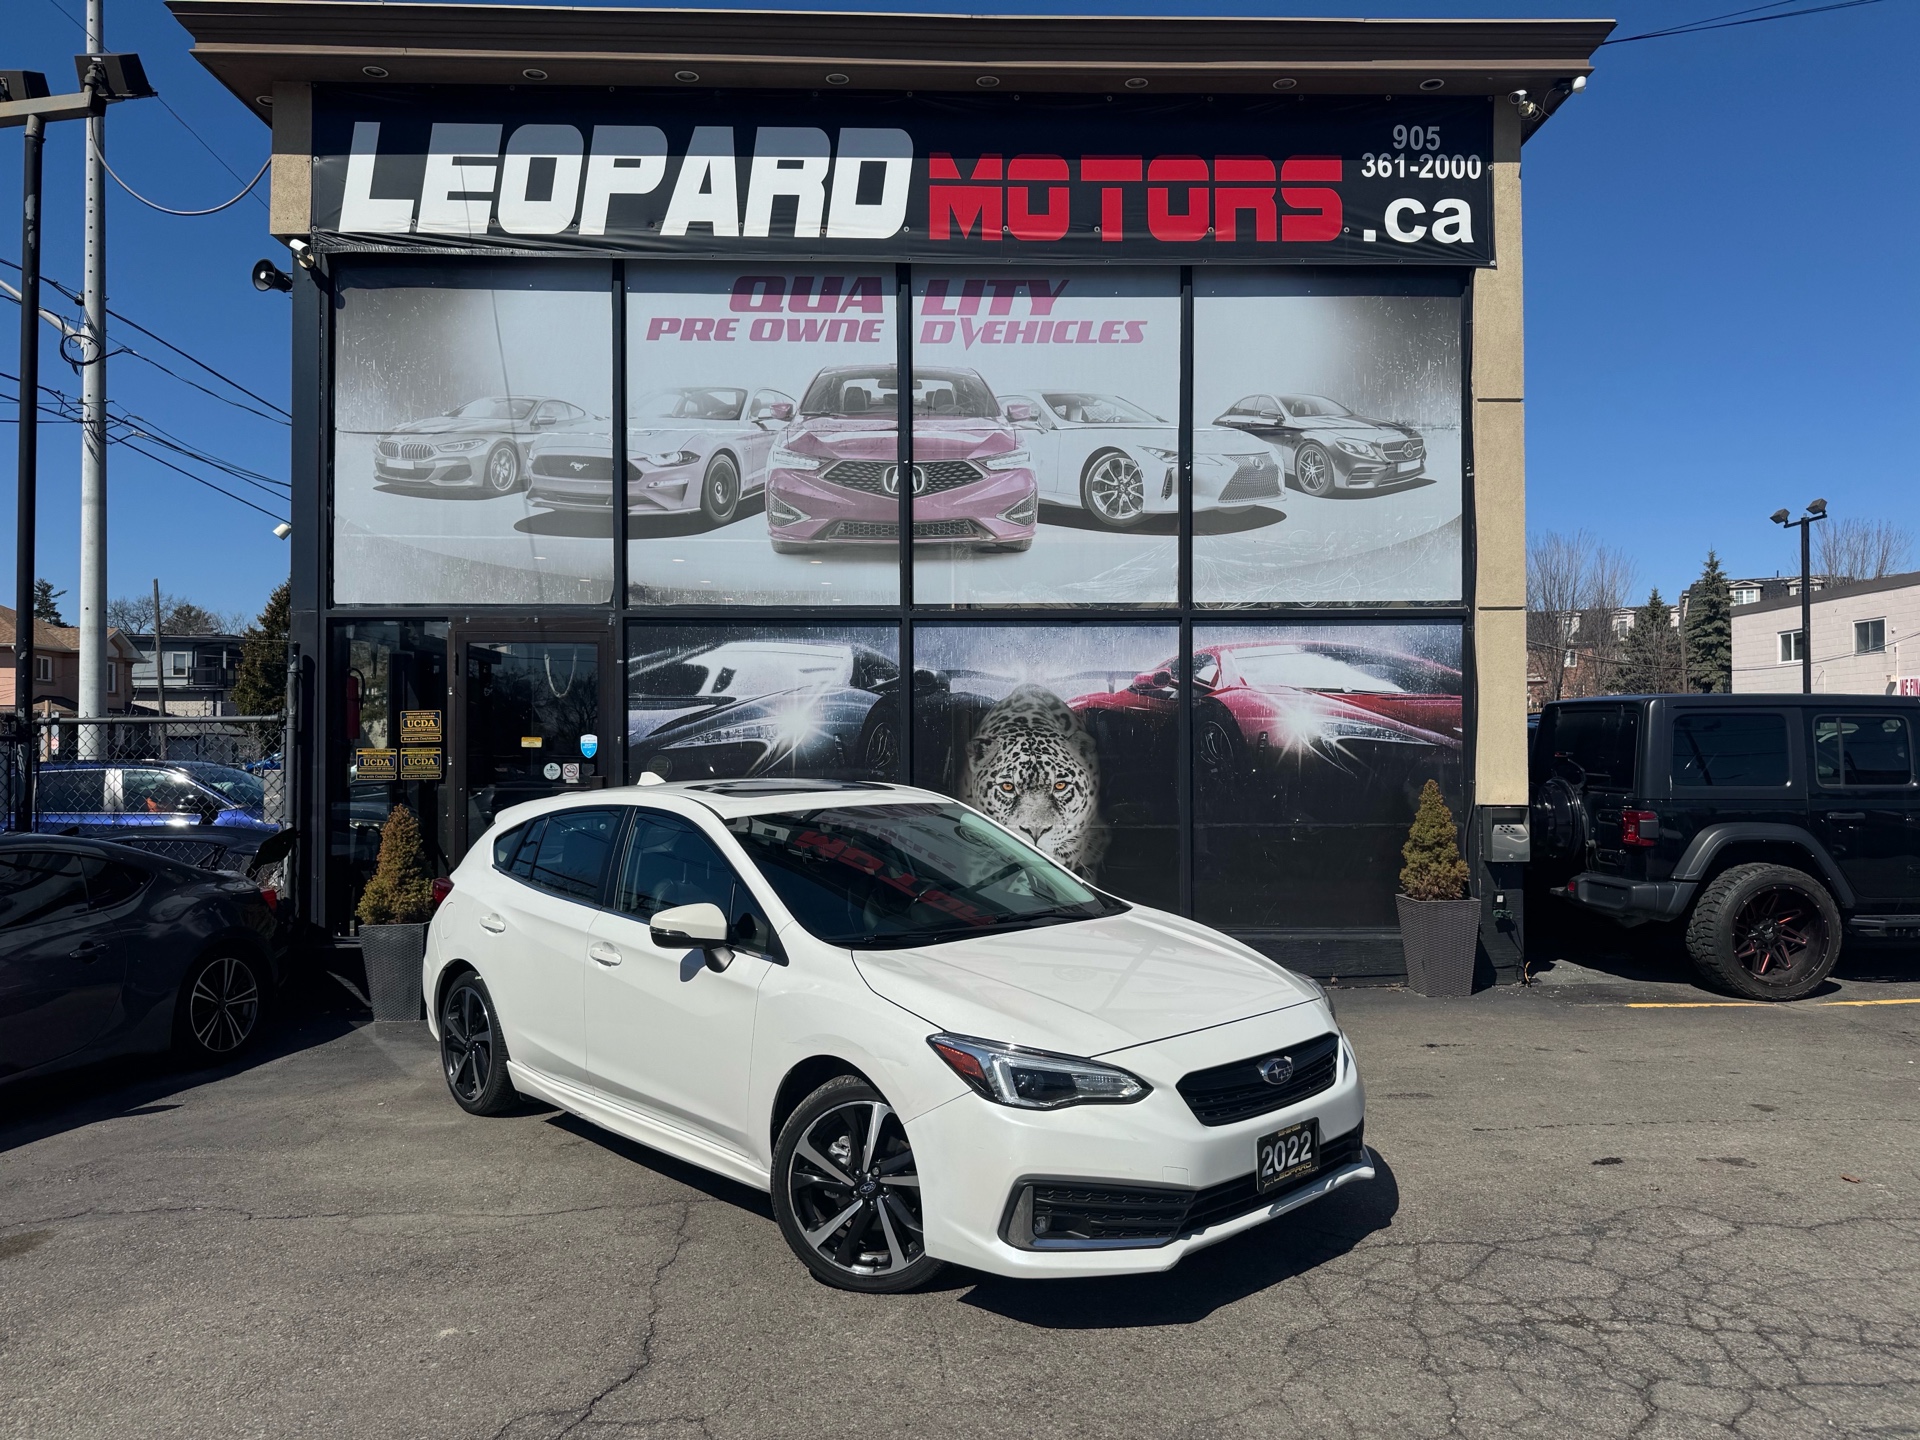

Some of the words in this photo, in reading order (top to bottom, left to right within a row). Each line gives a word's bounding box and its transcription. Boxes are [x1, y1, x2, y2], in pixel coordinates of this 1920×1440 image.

[1392, 124, 1441, 151] 905
[1361, 152, 1482, 179] 361-2000
[338, 121, 914, 239] LEOPARD
[929, 152, 1343, 242] MOTORS
[1363, 197, 1475, 244] .ca
[646, 317, 740, 341] PRE
[1910, 679, 1920, 696] FIN
[407, 719, 435, 728] UCDA
[363, 758, 391, 766] UCDA
[1261, 1131, 1312, 1178] 2022
